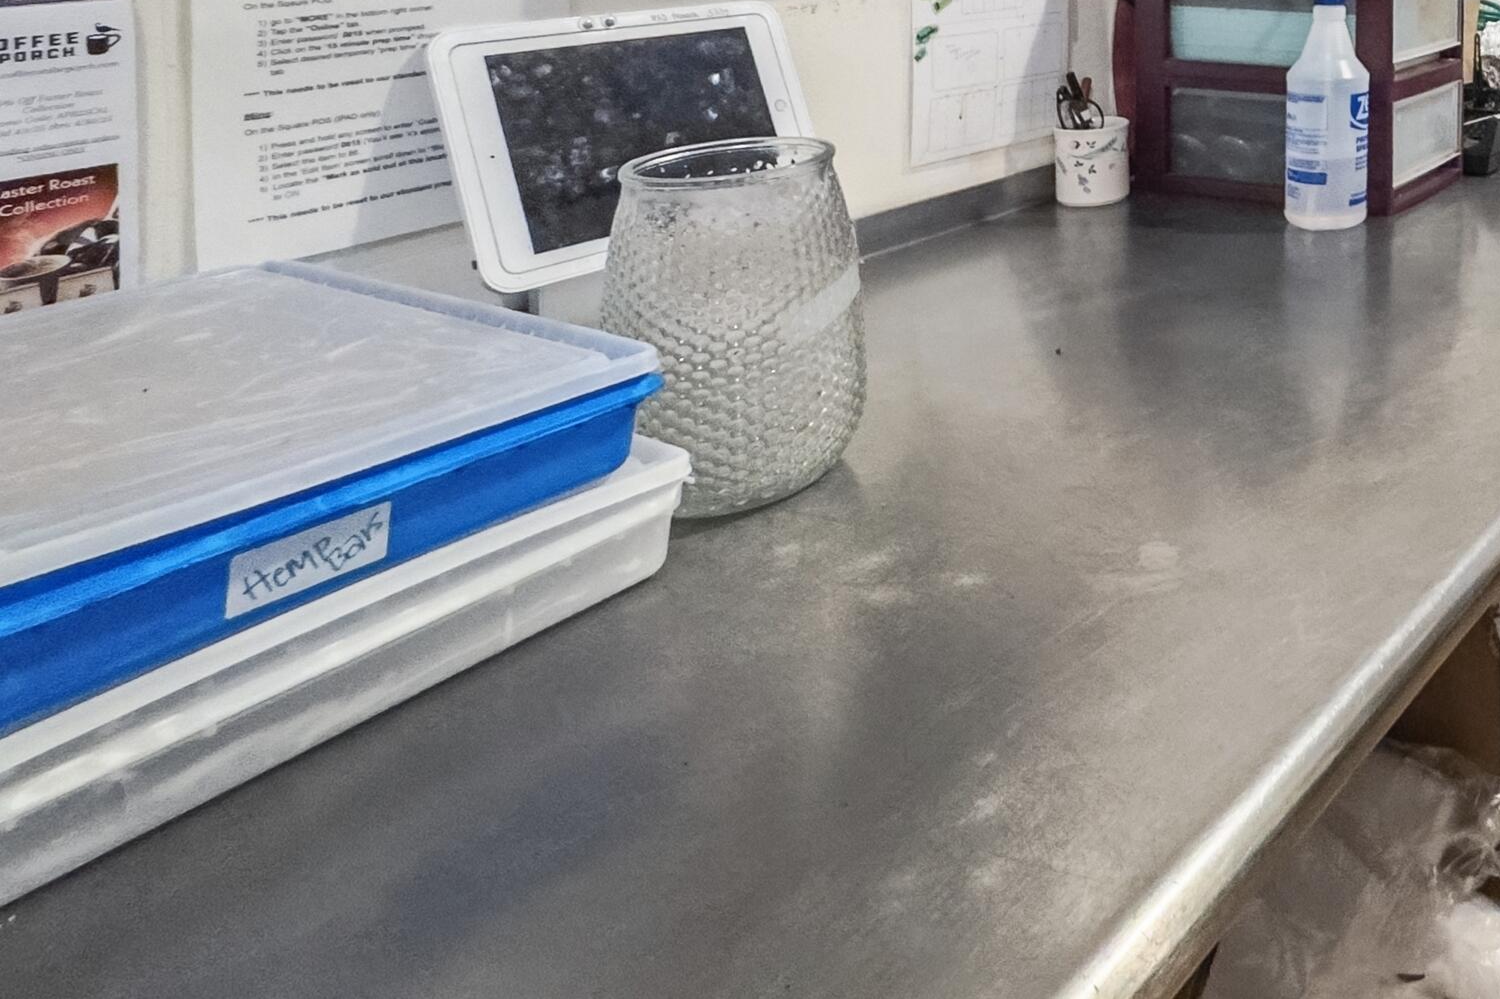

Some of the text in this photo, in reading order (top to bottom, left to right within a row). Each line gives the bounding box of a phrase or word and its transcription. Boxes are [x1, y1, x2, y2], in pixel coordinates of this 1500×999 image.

[0, 32, 79, 51] OFFEE
[0, 47, 75, 64] PORCH
[0, 175, 96, 199] aster Roast
[0, 194, 89, 217] Collection
